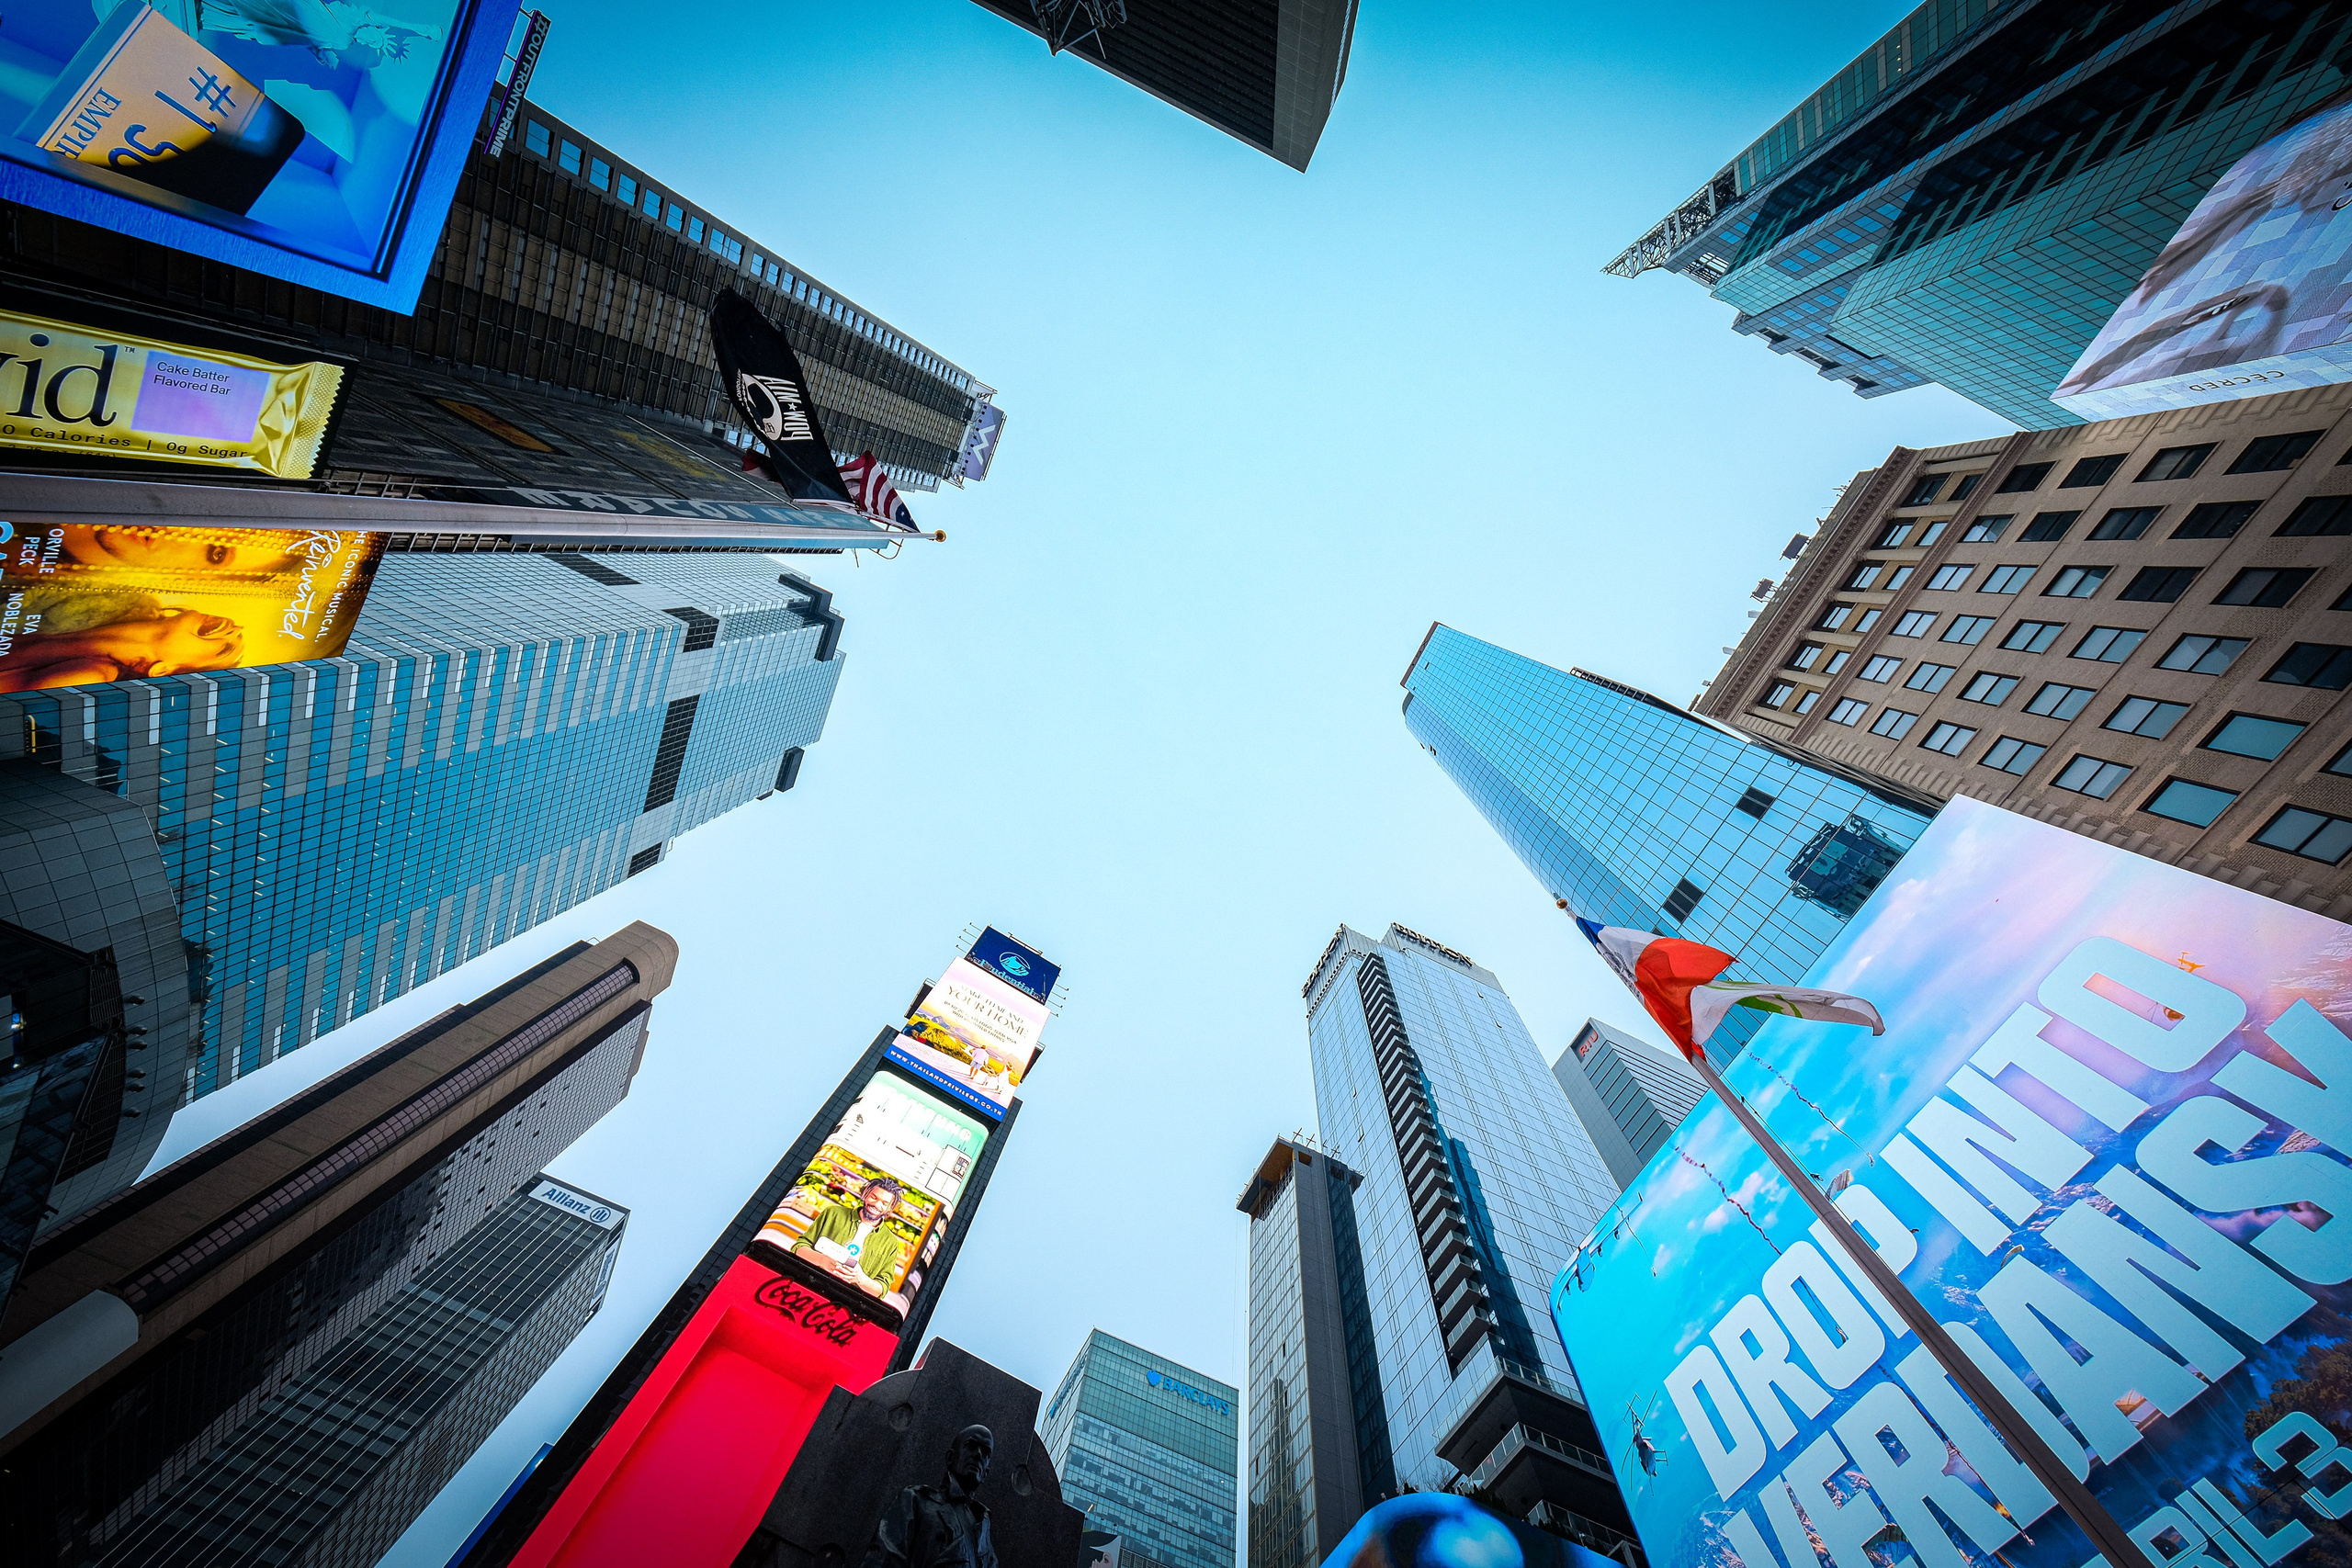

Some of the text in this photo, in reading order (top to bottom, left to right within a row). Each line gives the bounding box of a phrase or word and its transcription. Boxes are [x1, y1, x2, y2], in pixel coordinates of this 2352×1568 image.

[490, 16, 548, 158] #OUTFRONTPRIME
[153, 374, 231, 395] Flavored Bar
[157, 361, 230, 383] Cake Batter
[30, 426, 131, 447] Calories
[166, 442, 187, 454] 0g
[198, 445, 247, 458] Sugar
[18, 536, 40, 565] PECK
[39, 528, 64, 573] ORVILLE
[336, 548, 360, 588] ICONIC
[0, 592, 25, 657] NOBLEZADA
[22, 614, 41, 635] EVA
[314, 592, 344, 642] MUSICAL.
[979, 958, 1035, 996] Pudential
[948, 986, 1029, 1039] YOUR HOME
[1578, 1030, 1599, 1057] RIU
[889, 1050, 1002, 1116] WWW.THAILANDPRIVILEGE.CO.TH
[882, 1085, 972, 1142] SUNG
[541, 1187, 592, 1214] Allianz
[1663, 936, 2247, 1502] DROP INTO
[754, 1275, 862, 1348] Coca-Cola
[1162, 1376, 1230, 1416] BARCLAYS
[2080, 1476, 2314, 1568] RIL
